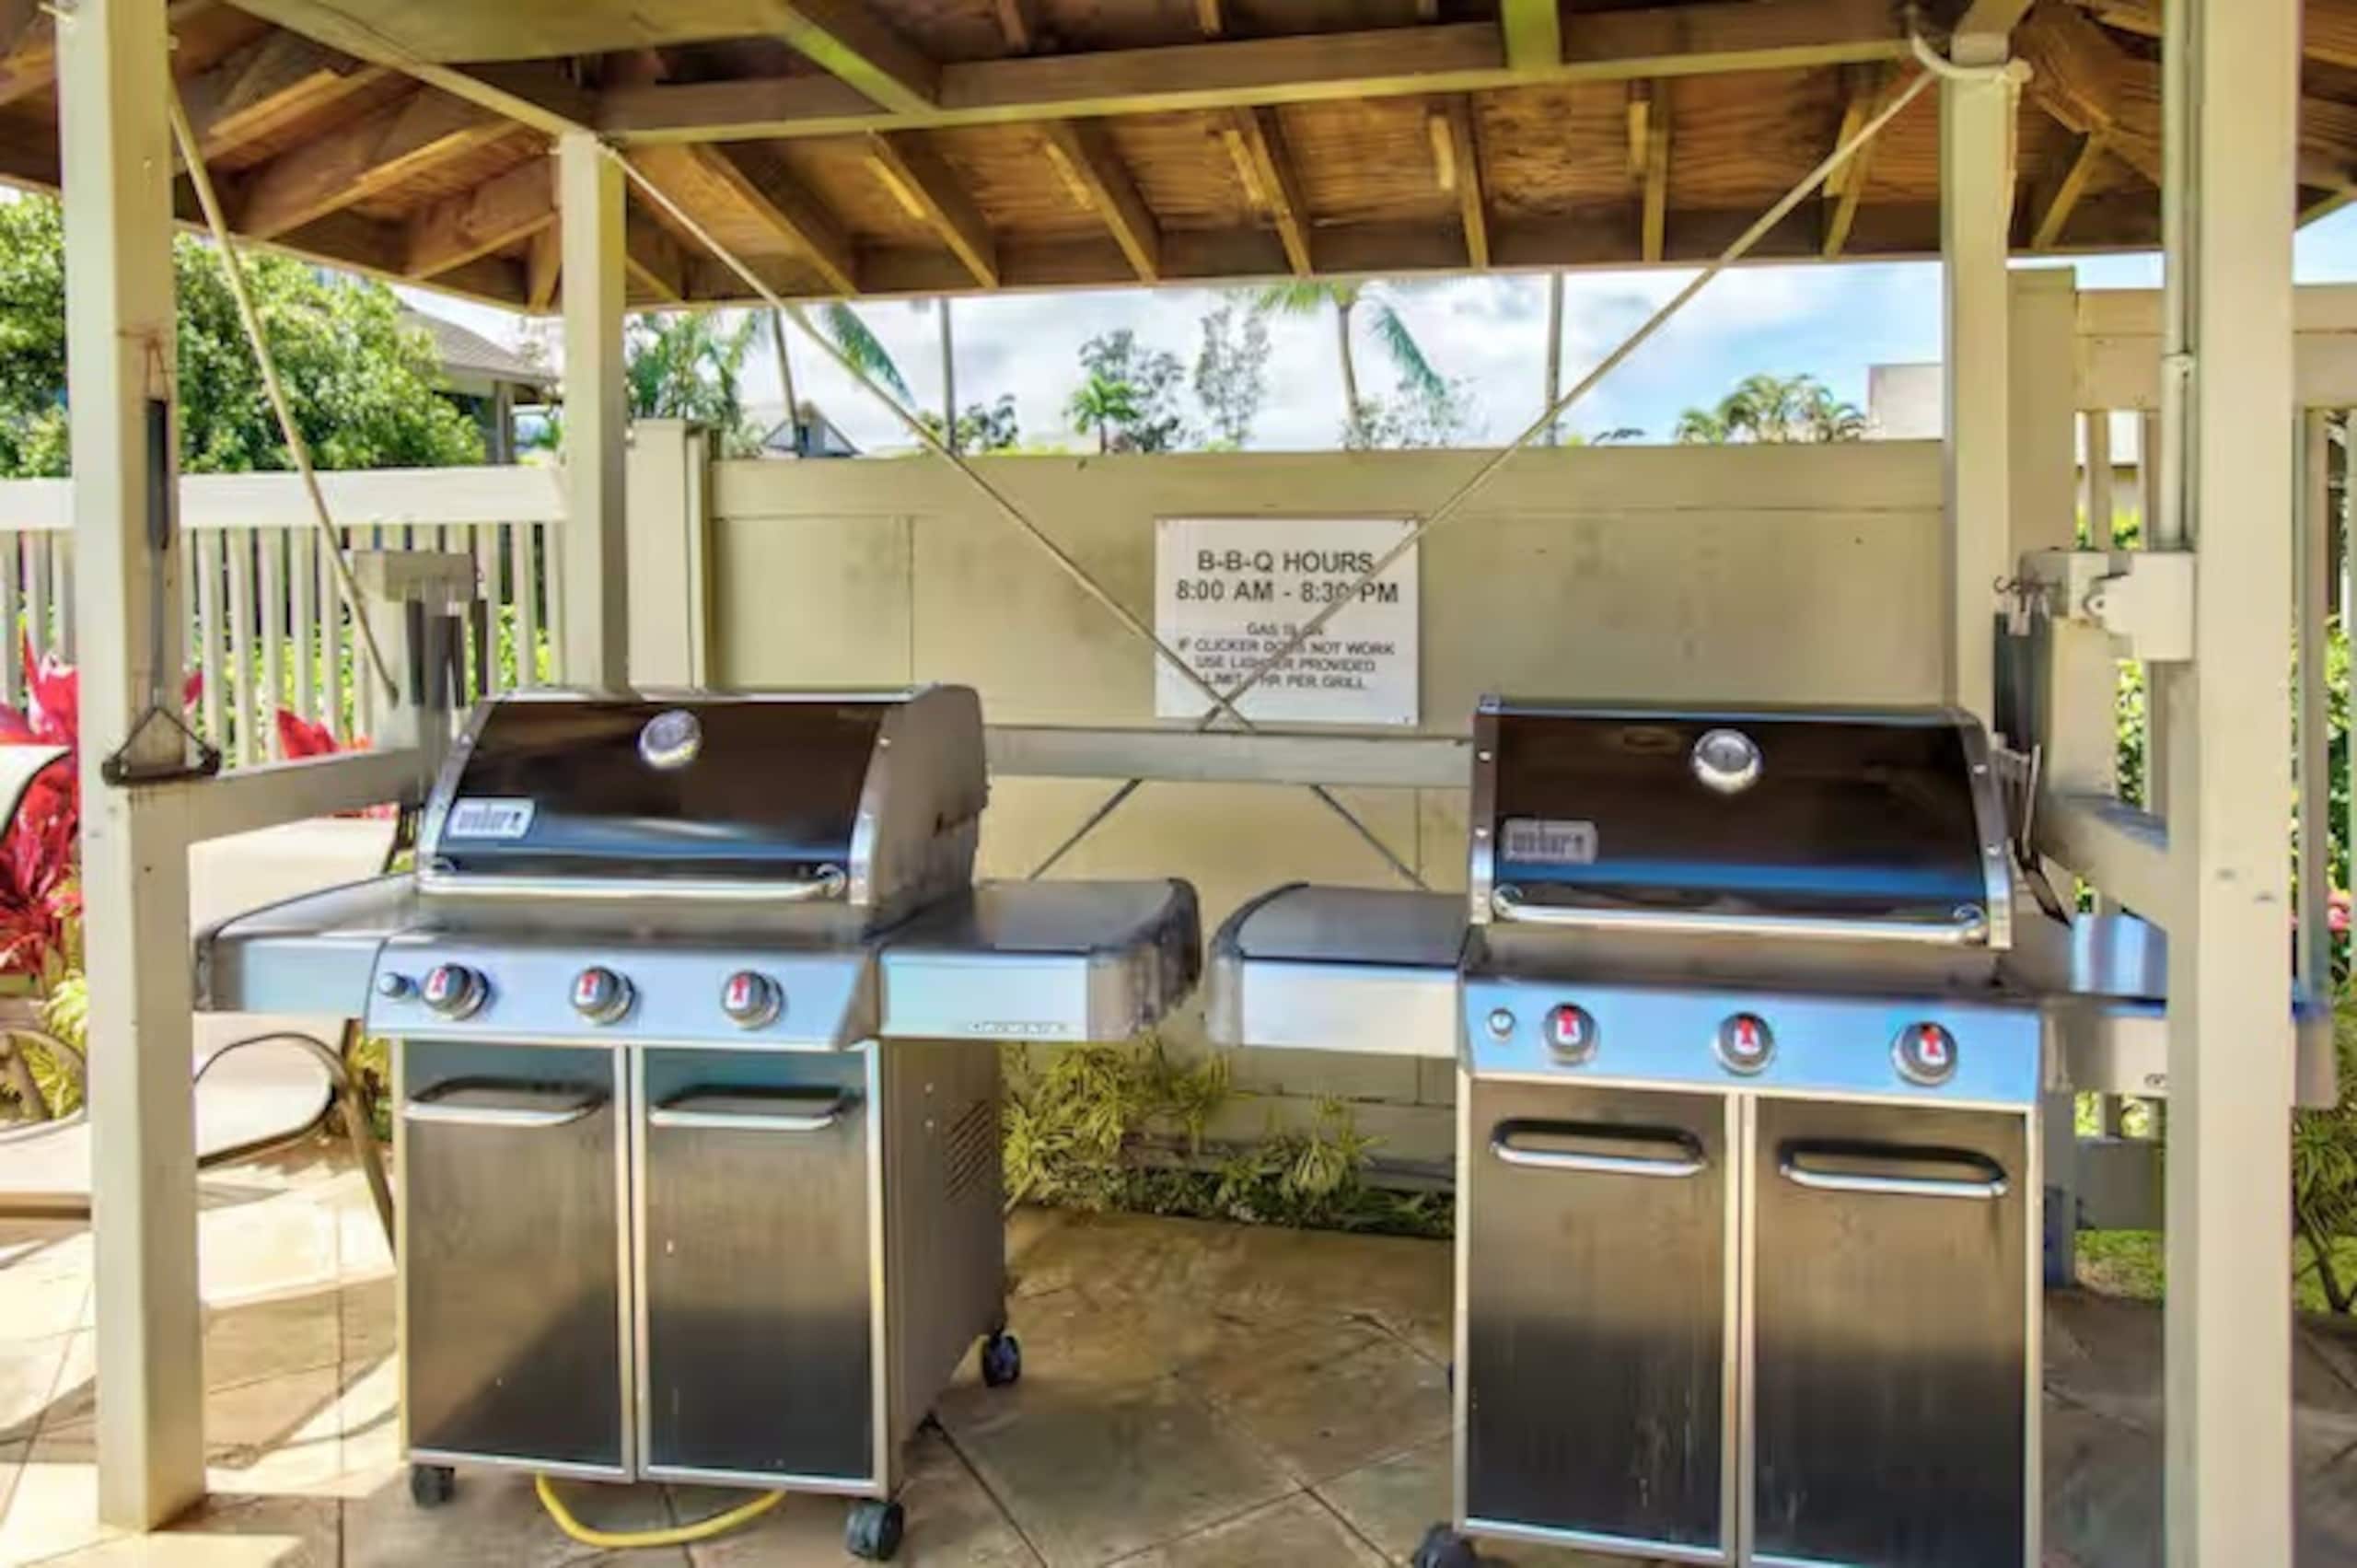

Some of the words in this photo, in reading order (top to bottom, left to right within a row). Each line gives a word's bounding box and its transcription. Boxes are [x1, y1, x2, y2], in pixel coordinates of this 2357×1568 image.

[1198, 550, 1273, 572] B-B-Q
[1283, 551, 1373, 573] HOURS
[1177, 579, 1225, 600] 8:00
[1234, 581, 1273, 601] AM
[1301, 581, 1352, 603] 8:30
[1360, 582, 1399, 603] PM
[1246, 622, 1278, 635] GAS
[1194, 638, 1259, 652] CLICKER
[1311, 642, 1341, 655] NOT
[1346, 642, 1395, 656] WORK
[1195, 655, 1224, 668] USE
[1299, 657, 1376, 672] PROVIDED
[1286, 674, 1317, 688] PER
[1322, 675, 1364, 691] GRILL
